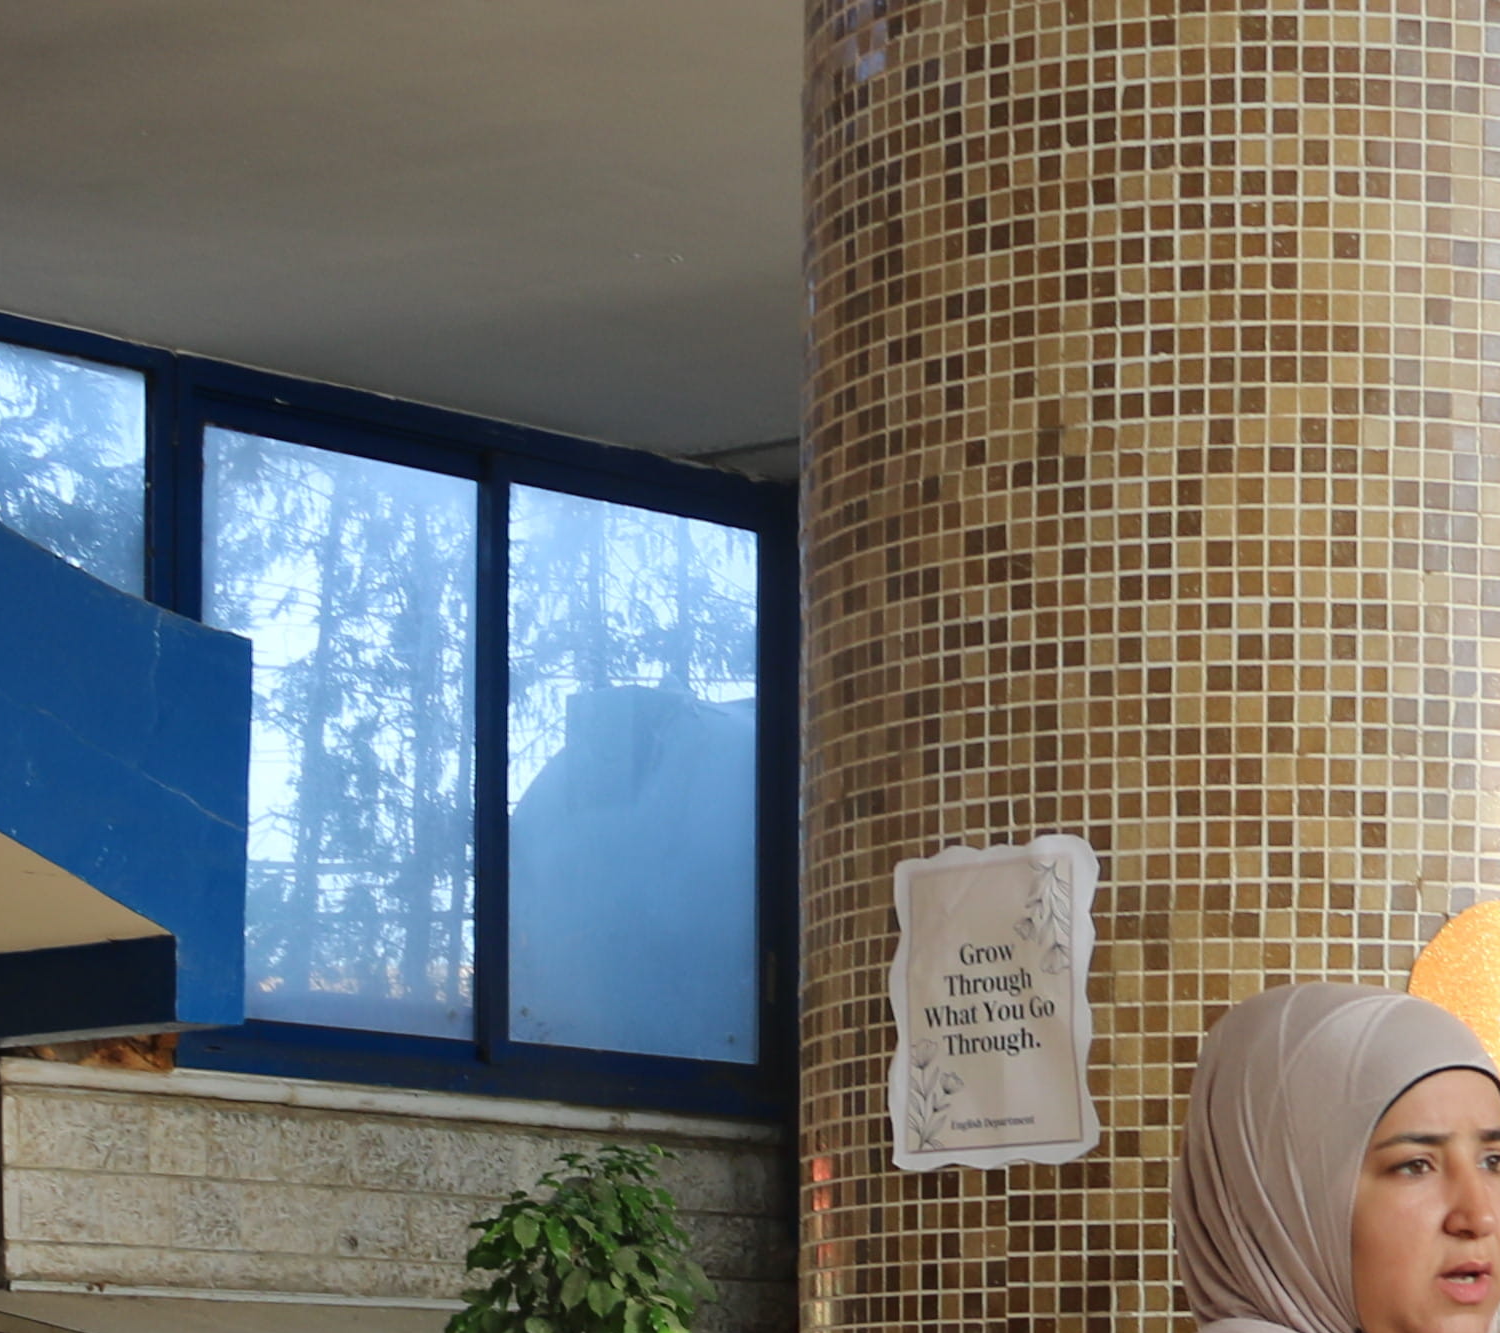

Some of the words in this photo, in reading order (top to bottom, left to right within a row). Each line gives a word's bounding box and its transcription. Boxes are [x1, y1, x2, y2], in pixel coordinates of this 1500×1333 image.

[959, 943, 1015, 966] Grow
[943, 967, 1032, 998] Through
[924, 1004, 978, 1028] What
[983, 1000, 1025, 1023] You
[1029, 995, 1055, 1019] Go
[942, 1027, 1041, 1057] Through.
